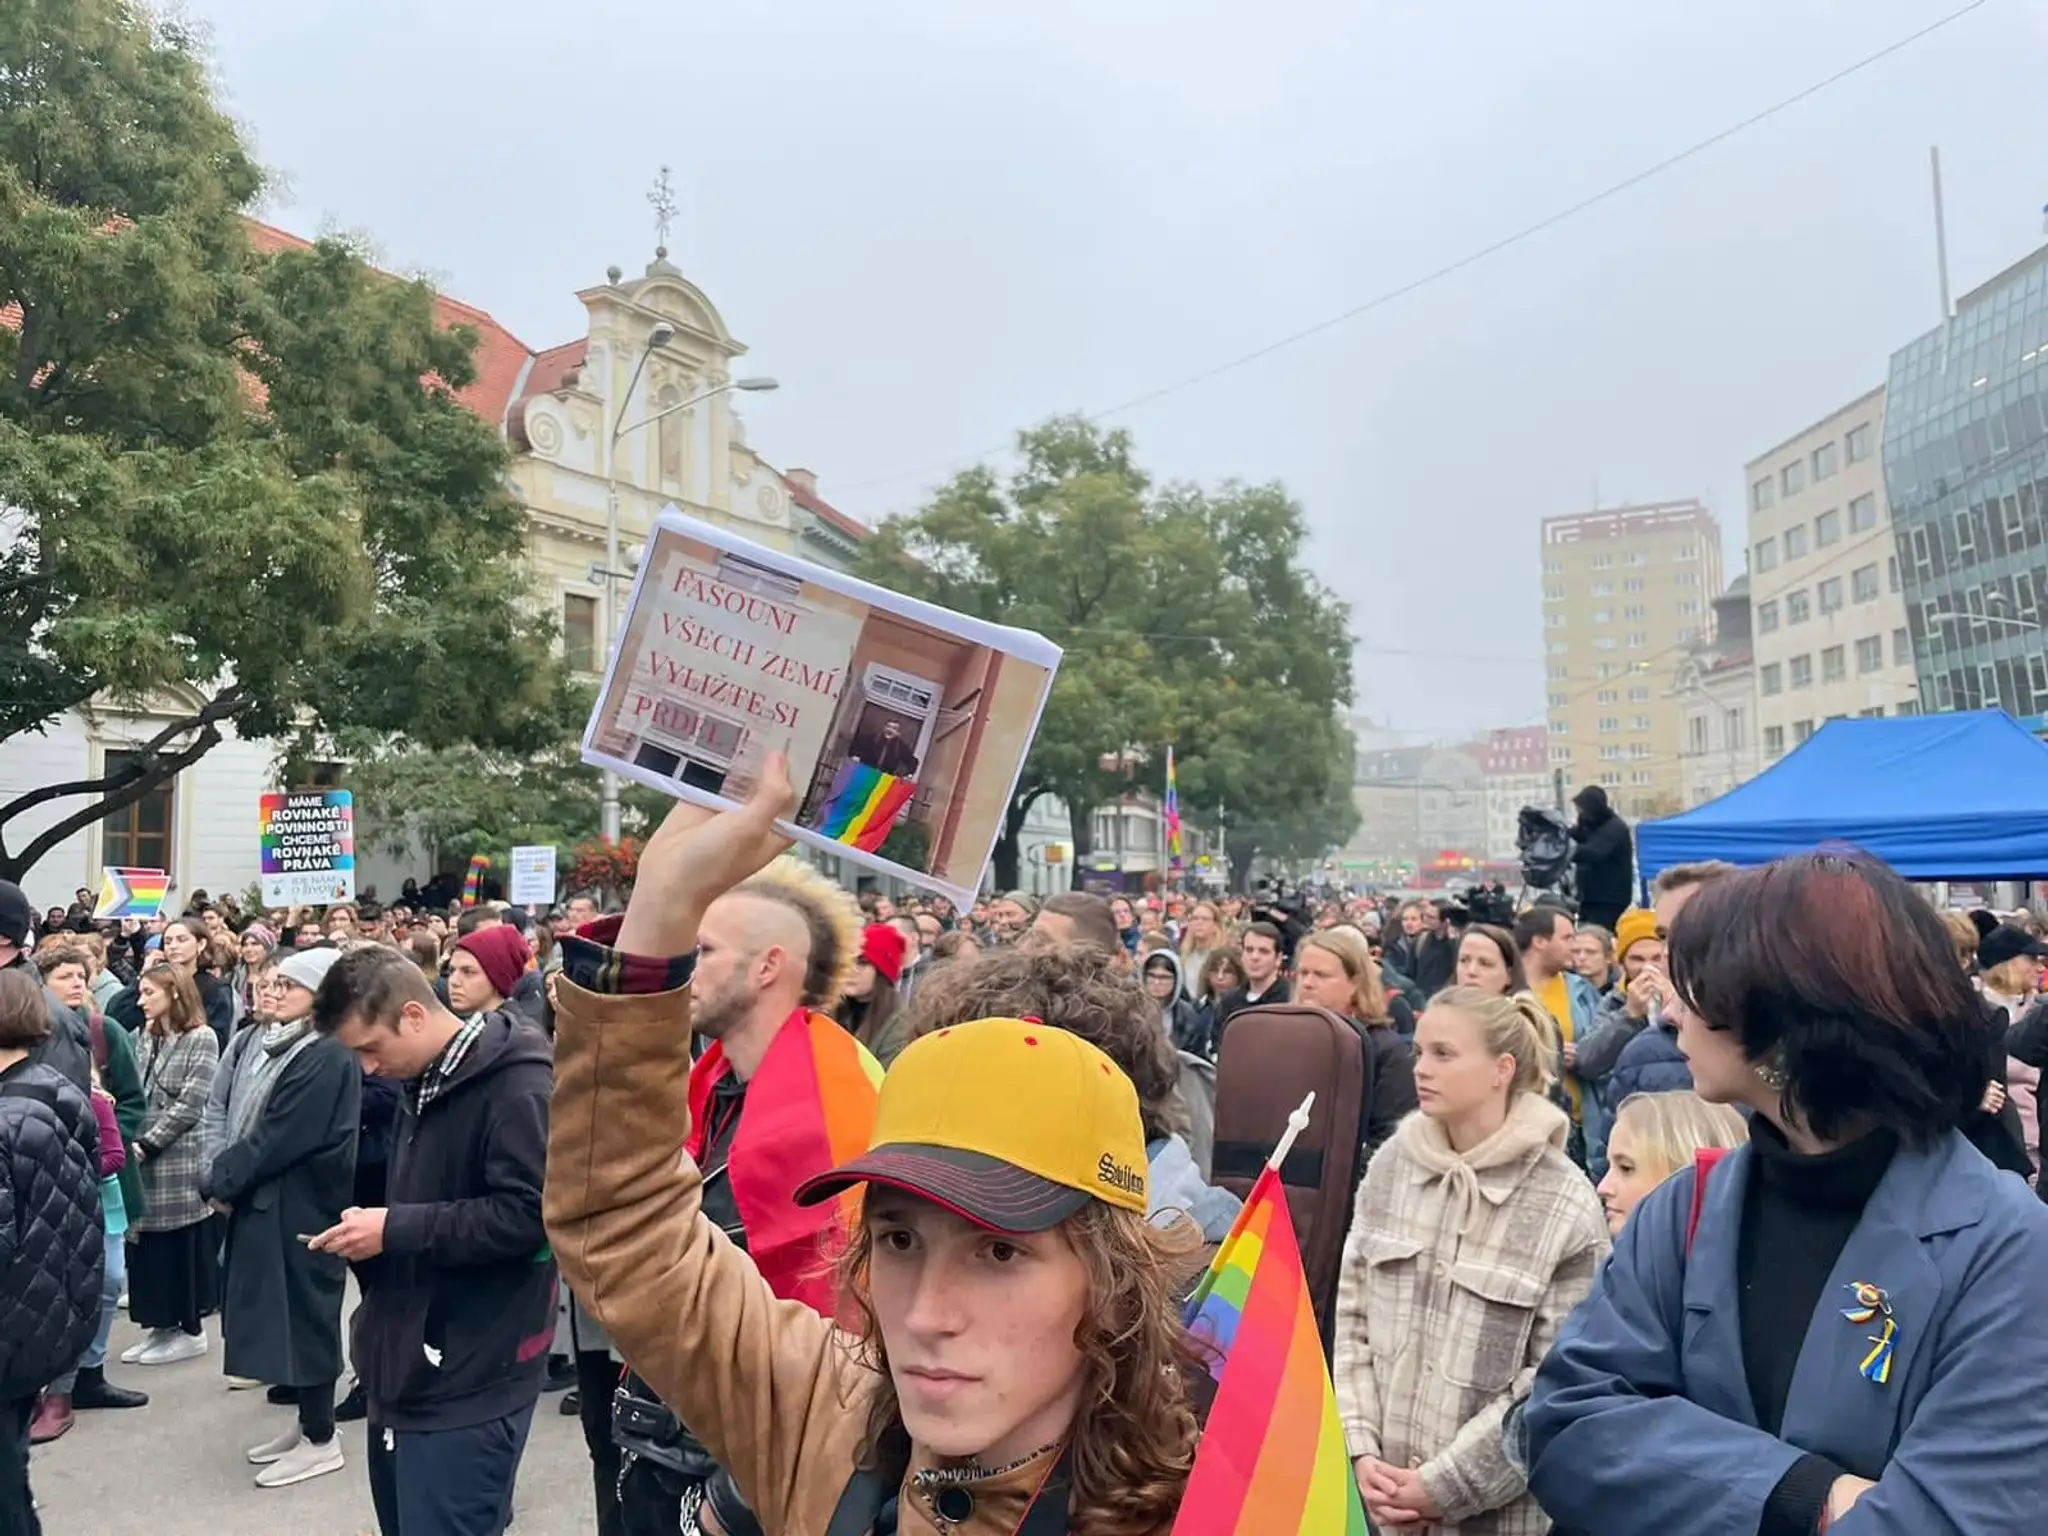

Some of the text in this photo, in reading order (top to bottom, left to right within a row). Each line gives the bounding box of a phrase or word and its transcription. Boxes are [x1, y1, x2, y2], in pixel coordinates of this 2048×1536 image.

[663, 611, 756, 666] VŠECH
[650, 650, 800, 728] VYLIŽTE SI
[288, 795, 323, 807] MÁME
[271, 806, 341, 821] ROVNAKÉ
[266, 820, 348, 835] POVINNOSTI
[282, 833, 331, 846] CHCEME
[272, 843, 341, 859] ROVNAKÉ
[283, 857, 332, 871] PRÁVA
